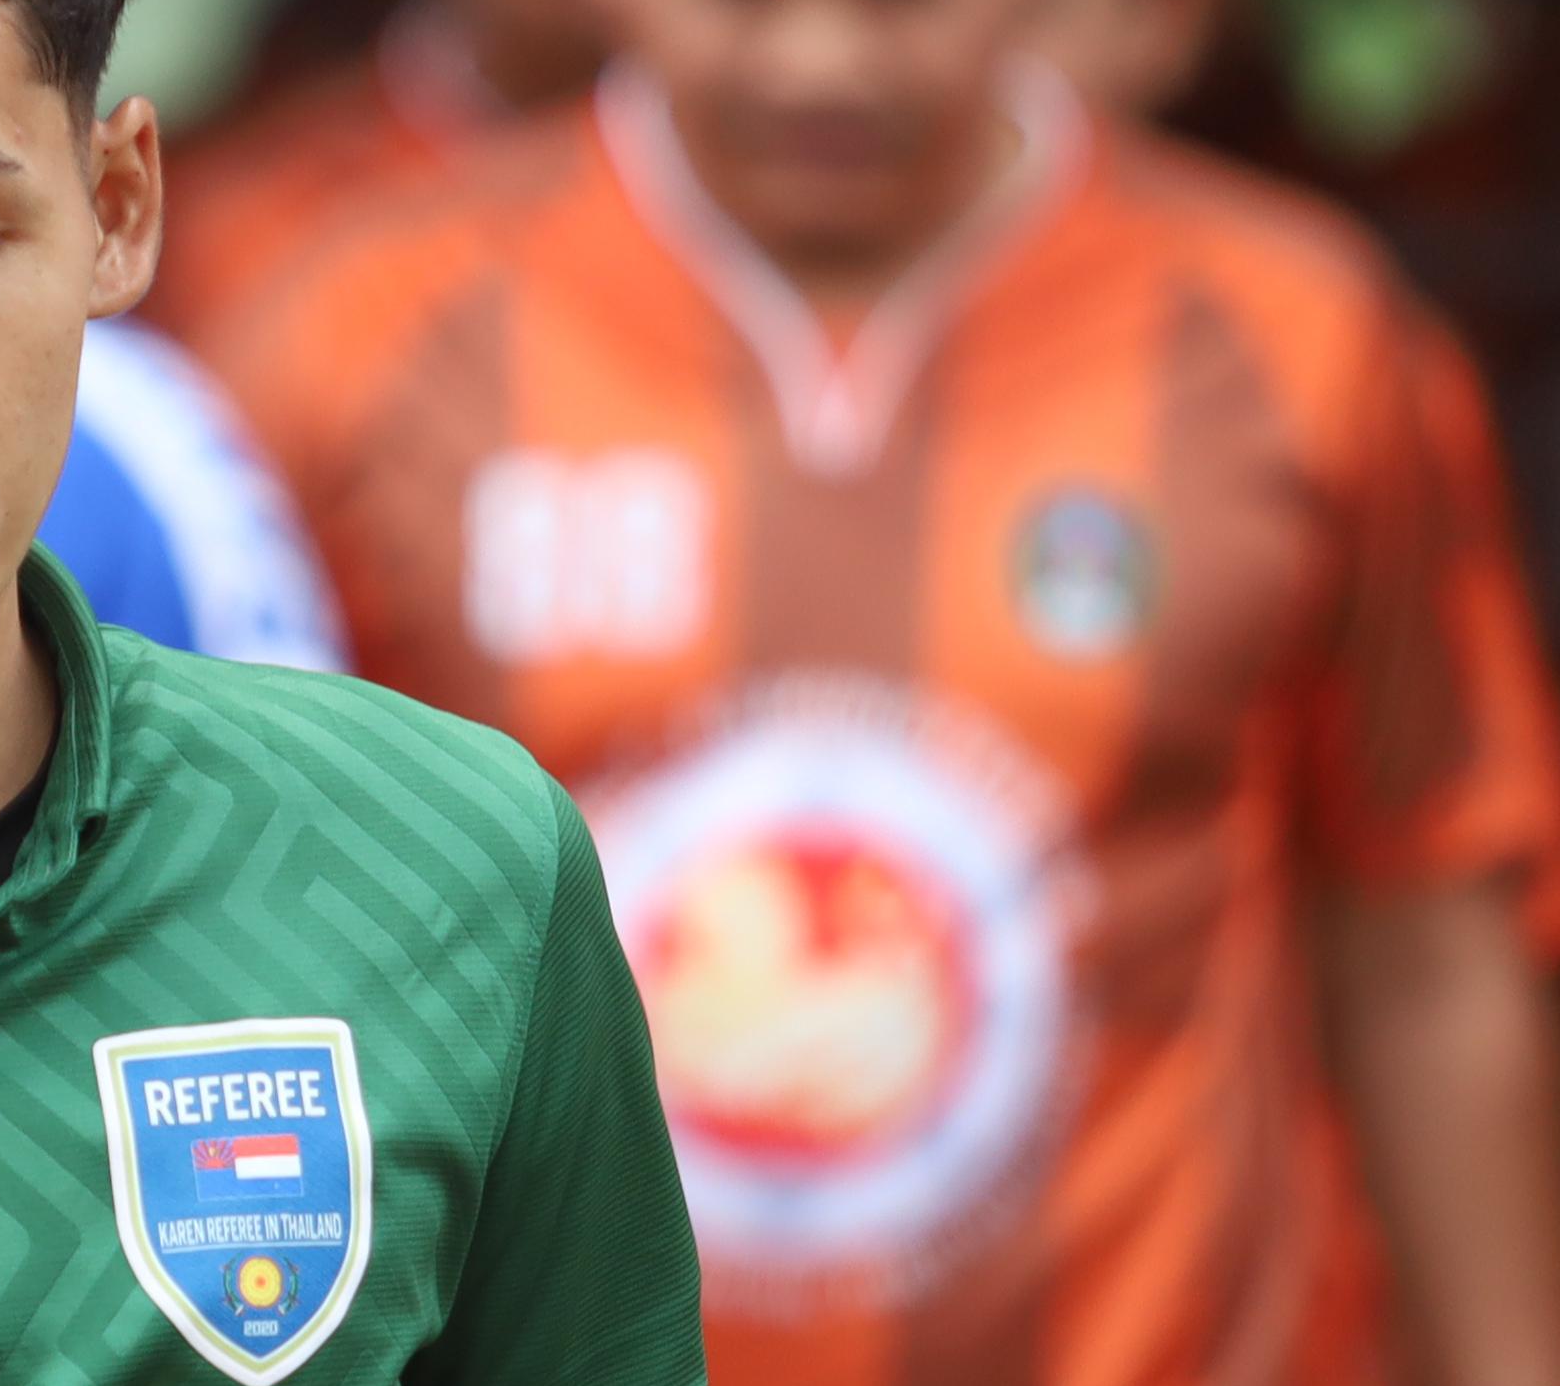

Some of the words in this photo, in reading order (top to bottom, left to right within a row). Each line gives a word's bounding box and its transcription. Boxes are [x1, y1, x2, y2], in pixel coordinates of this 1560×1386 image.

[144, 1070, 326, 1126] REFEREE
[158, 1218, 206, 1247] KAREN
[207, 1215, 264, 1243] REFEREE
[264, 1214, 279, 1240] IN
[280, 1212, 343, 1240] THAILAND
[243, 1319, 279, 1337] 2020
